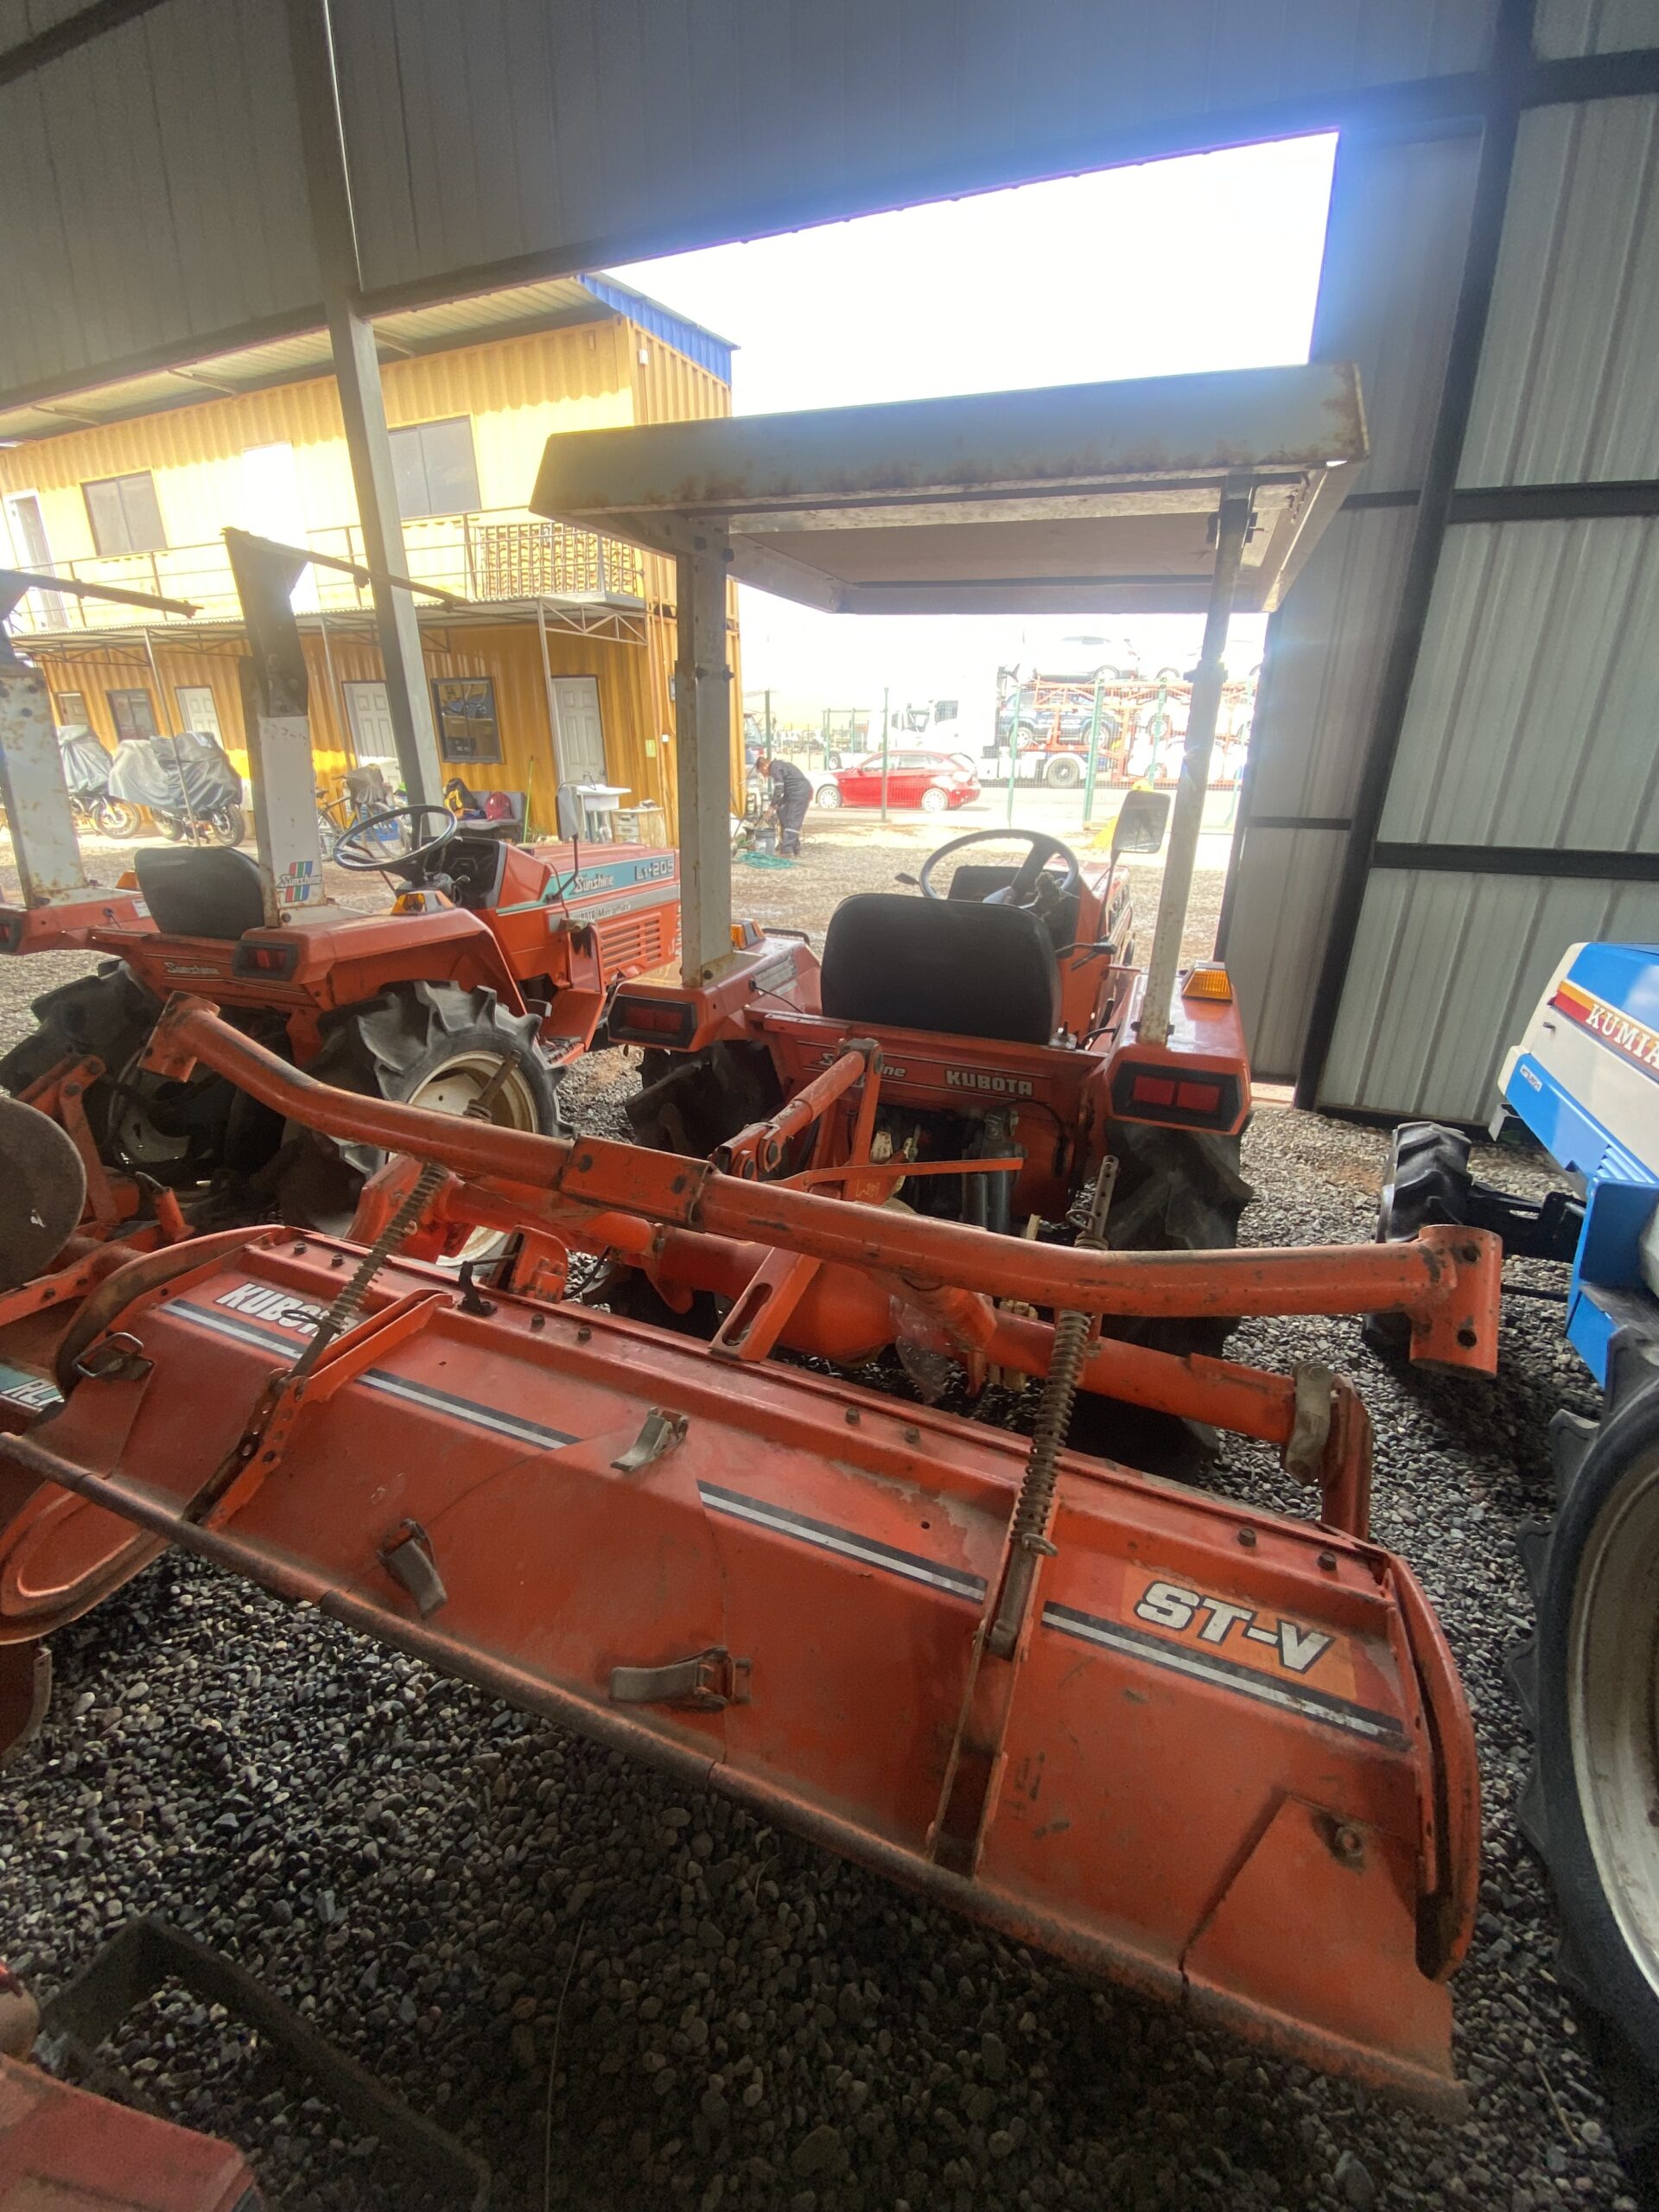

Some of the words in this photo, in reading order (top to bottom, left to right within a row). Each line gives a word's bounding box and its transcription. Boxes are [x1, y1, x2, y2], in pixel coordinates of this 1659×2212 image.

[574, 873, 614, 893] Sunshine
[945, 1070, 1033, 1096] KUBOTA
[1134, 1580, 1336, 1674] ST-V
